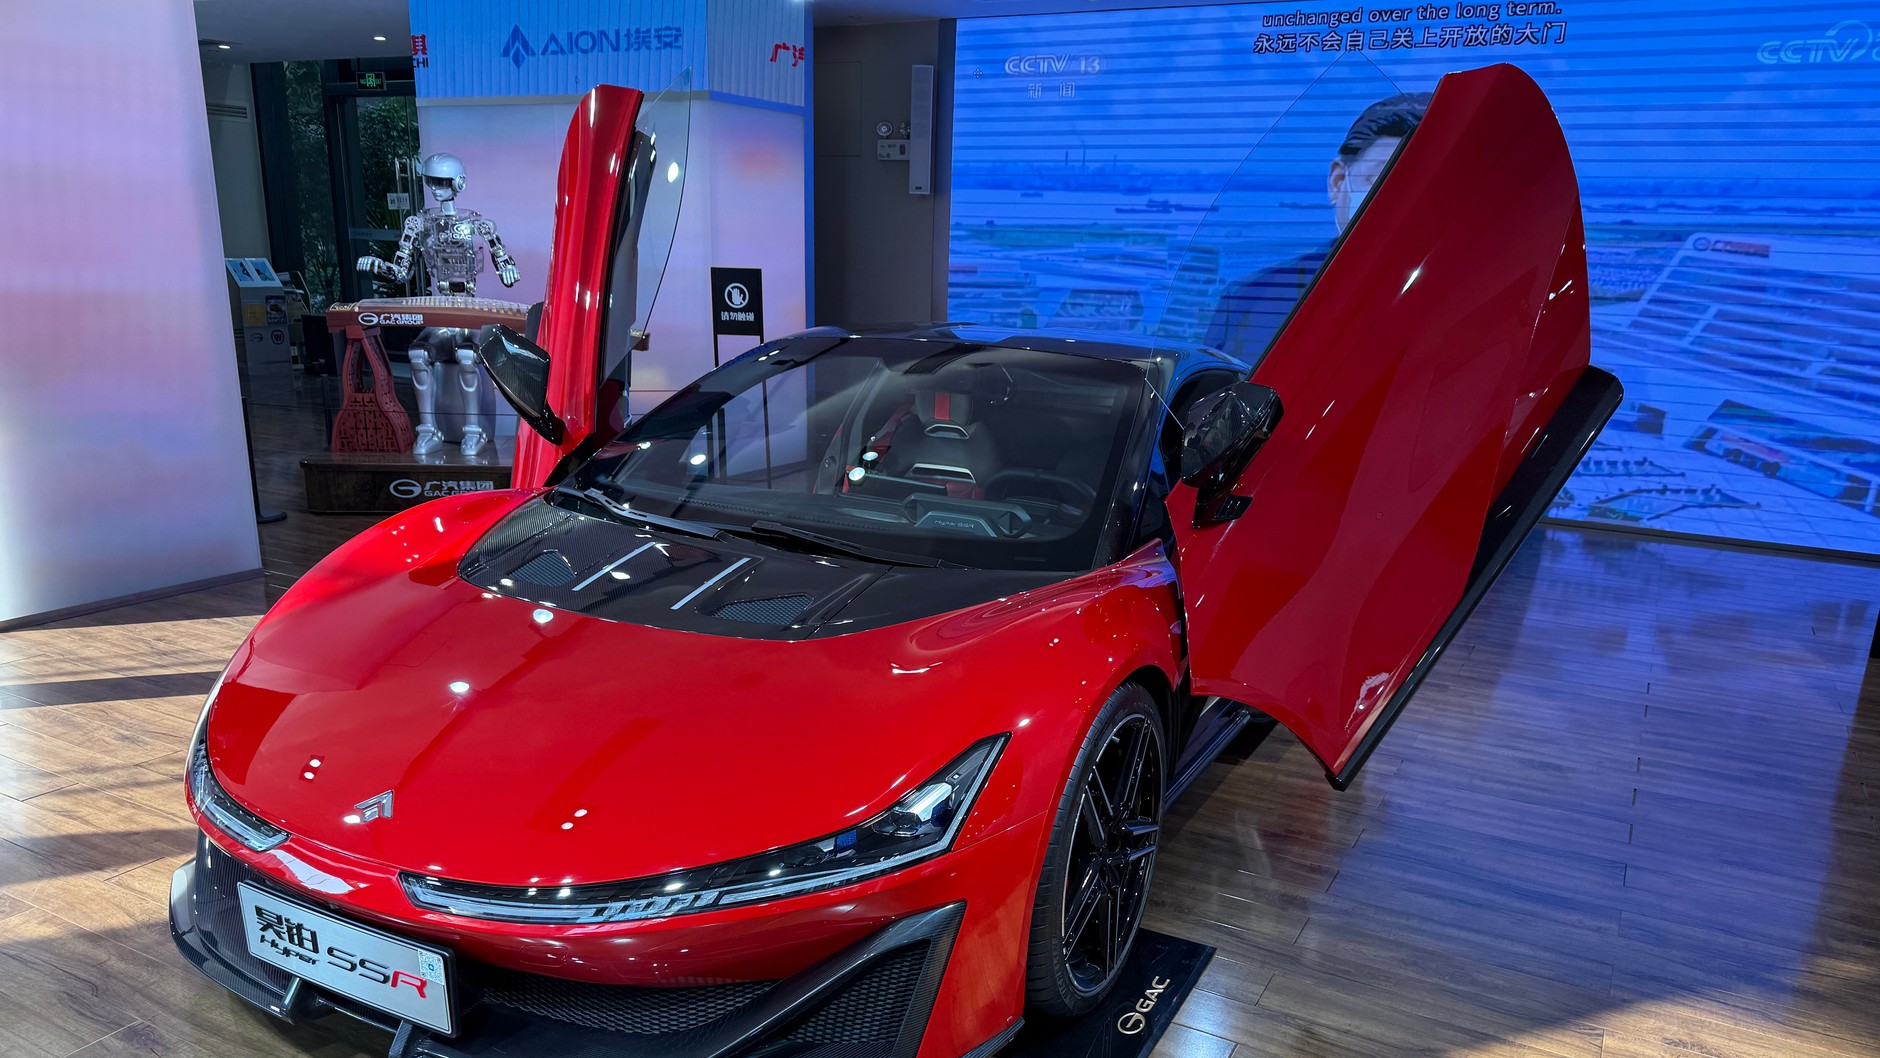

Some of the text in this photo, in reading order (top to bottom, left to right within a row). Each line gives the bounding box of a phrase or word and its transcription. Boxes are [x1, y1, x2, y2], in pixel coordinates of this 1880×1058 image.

[1263, 0, 1562, 27] unchanged over the long term.
[540, 26, 682, 55] AION 埃安
[1253, 21, 1567, 54] 永远不会自己关上开放的大门
[1005, 53, 1100, 75] CCTV 13
[380, 313, 423, 321] 广汽集团
[721, 311, 755, 321] 请勿触碰
[424, 480, 494, 491] 广汽集团
[254, 904, 320, 954] 昊铂
[259, 934, 320, 965] Hyper
[326, 946, 428, 999] SSR
[1135, 975, 1171, 1013] GAC
